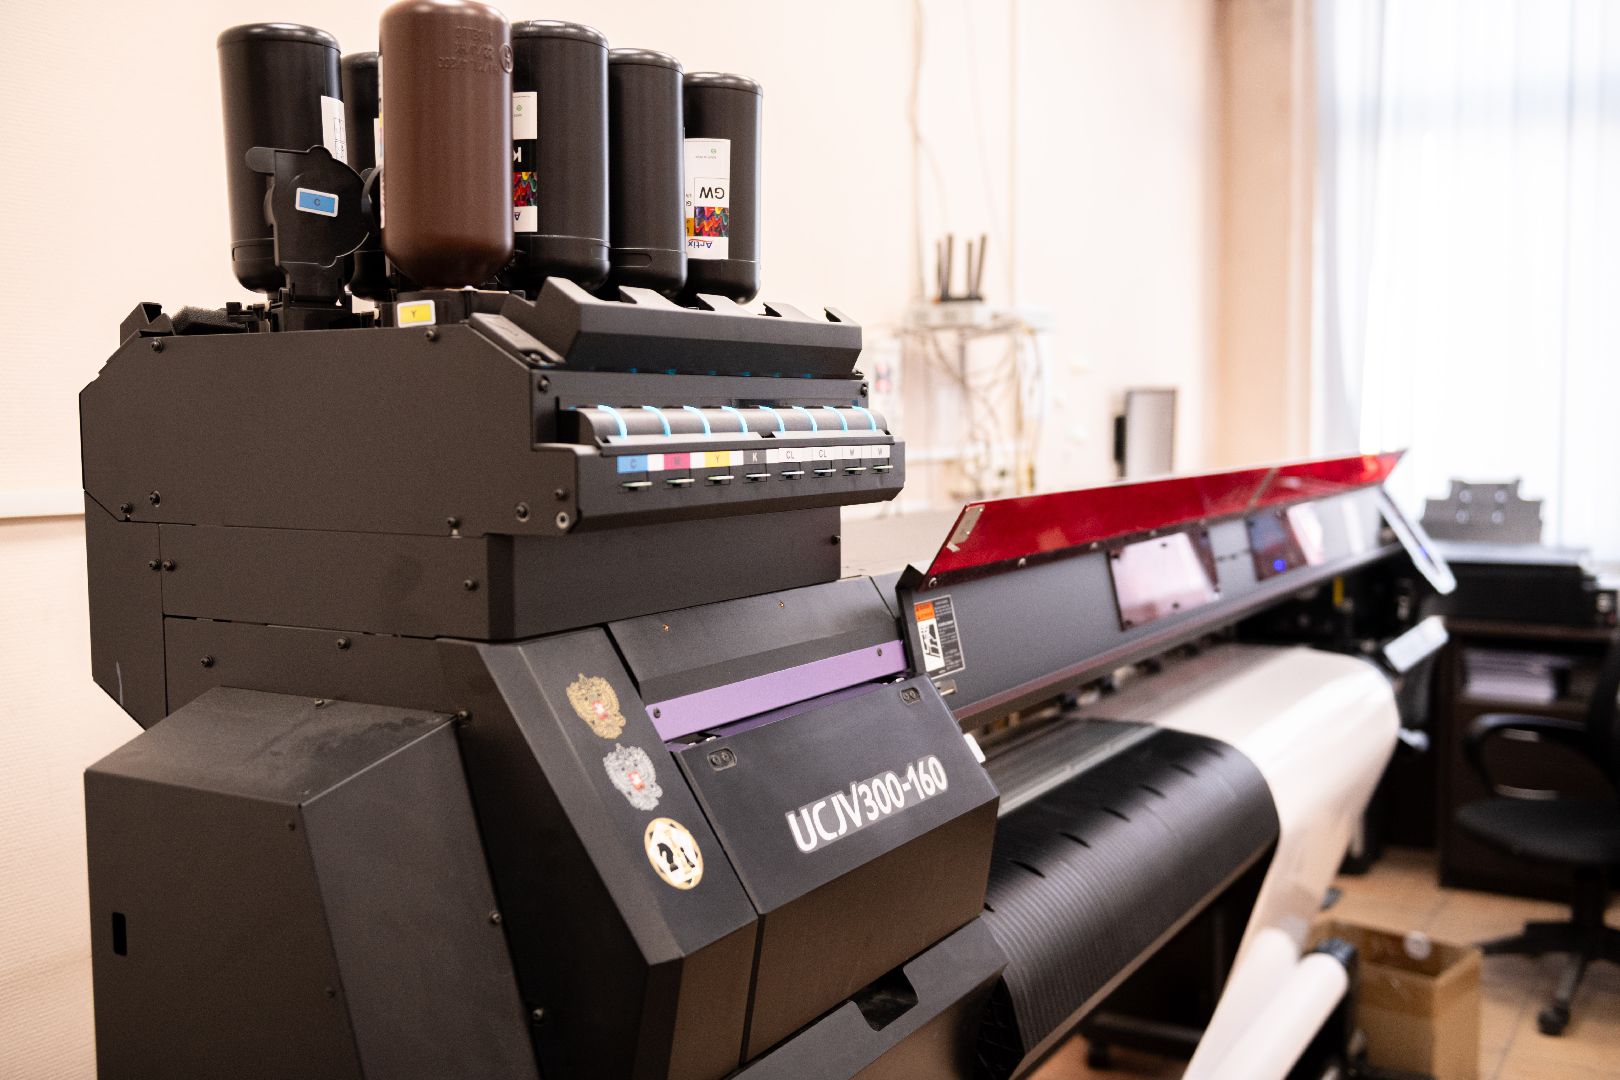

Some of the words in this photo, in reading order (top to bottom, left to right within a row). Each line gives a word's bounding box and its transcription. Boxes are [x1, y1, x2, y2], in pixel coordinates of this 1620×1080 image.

[699, 186, 725, 200] GW
[314, 198, 321, 207] C
[687, 239, 713, 249] Artix
[410, 310, 417, 319] Y
[630, 459, 637, 469] C
[751, 452, 758, 463] K
[785, 450, 795, 460] CL
[818, 449, 828, 459] CL
[788, 757, 946, 852] UCJV300-160
